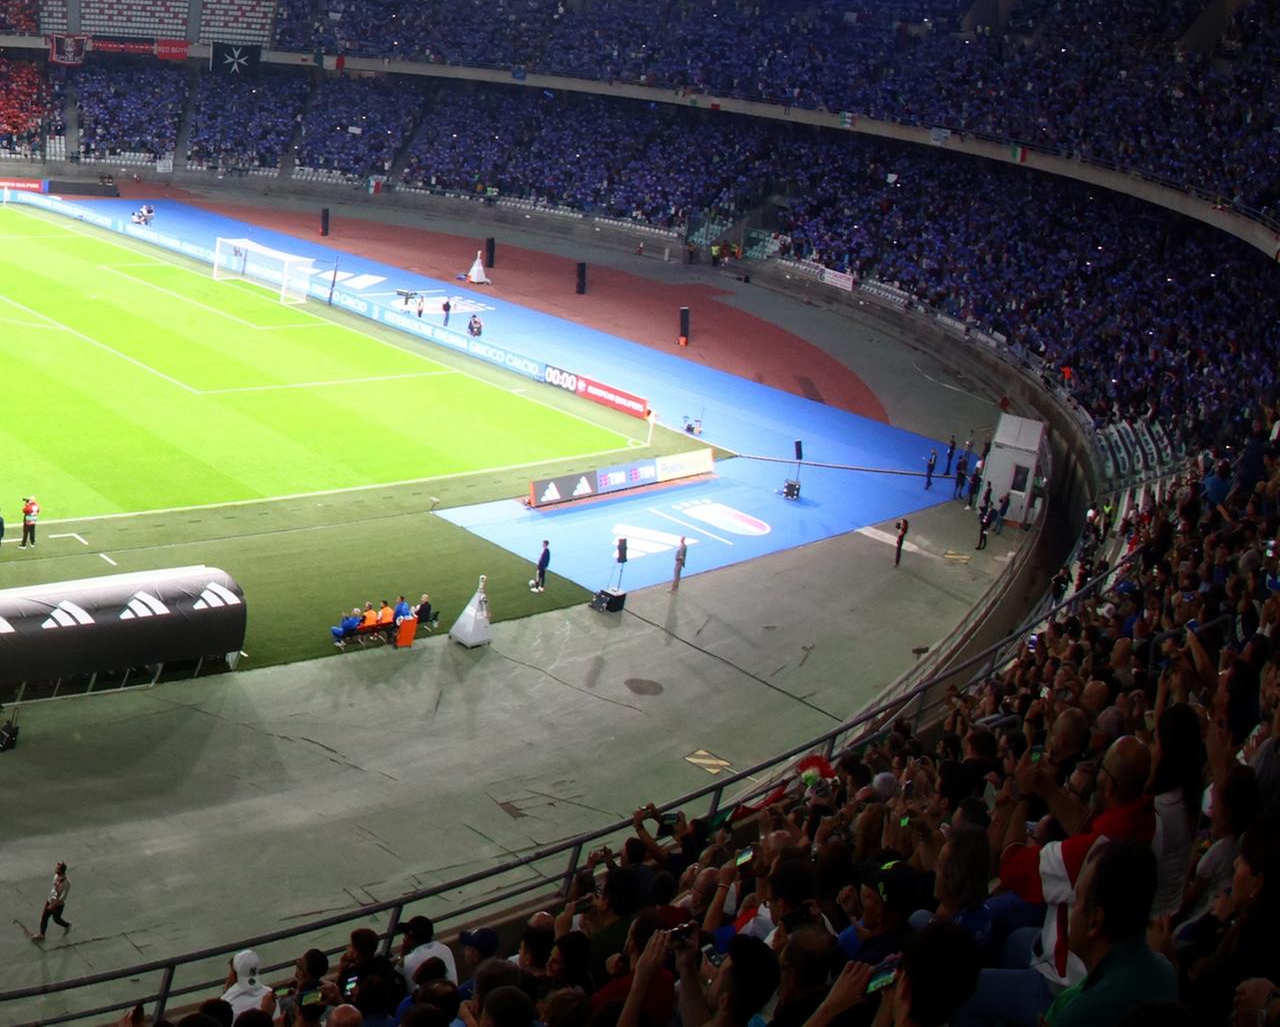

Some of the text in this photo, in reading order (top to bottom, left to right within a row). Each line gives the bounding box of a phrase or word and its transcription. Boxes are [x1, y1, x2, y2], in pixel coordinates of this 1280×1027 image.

[545, 366, 577, 391] 00:00
[609, 471, 626, 485] TIM
[640, 465, 656, 479] TIM
